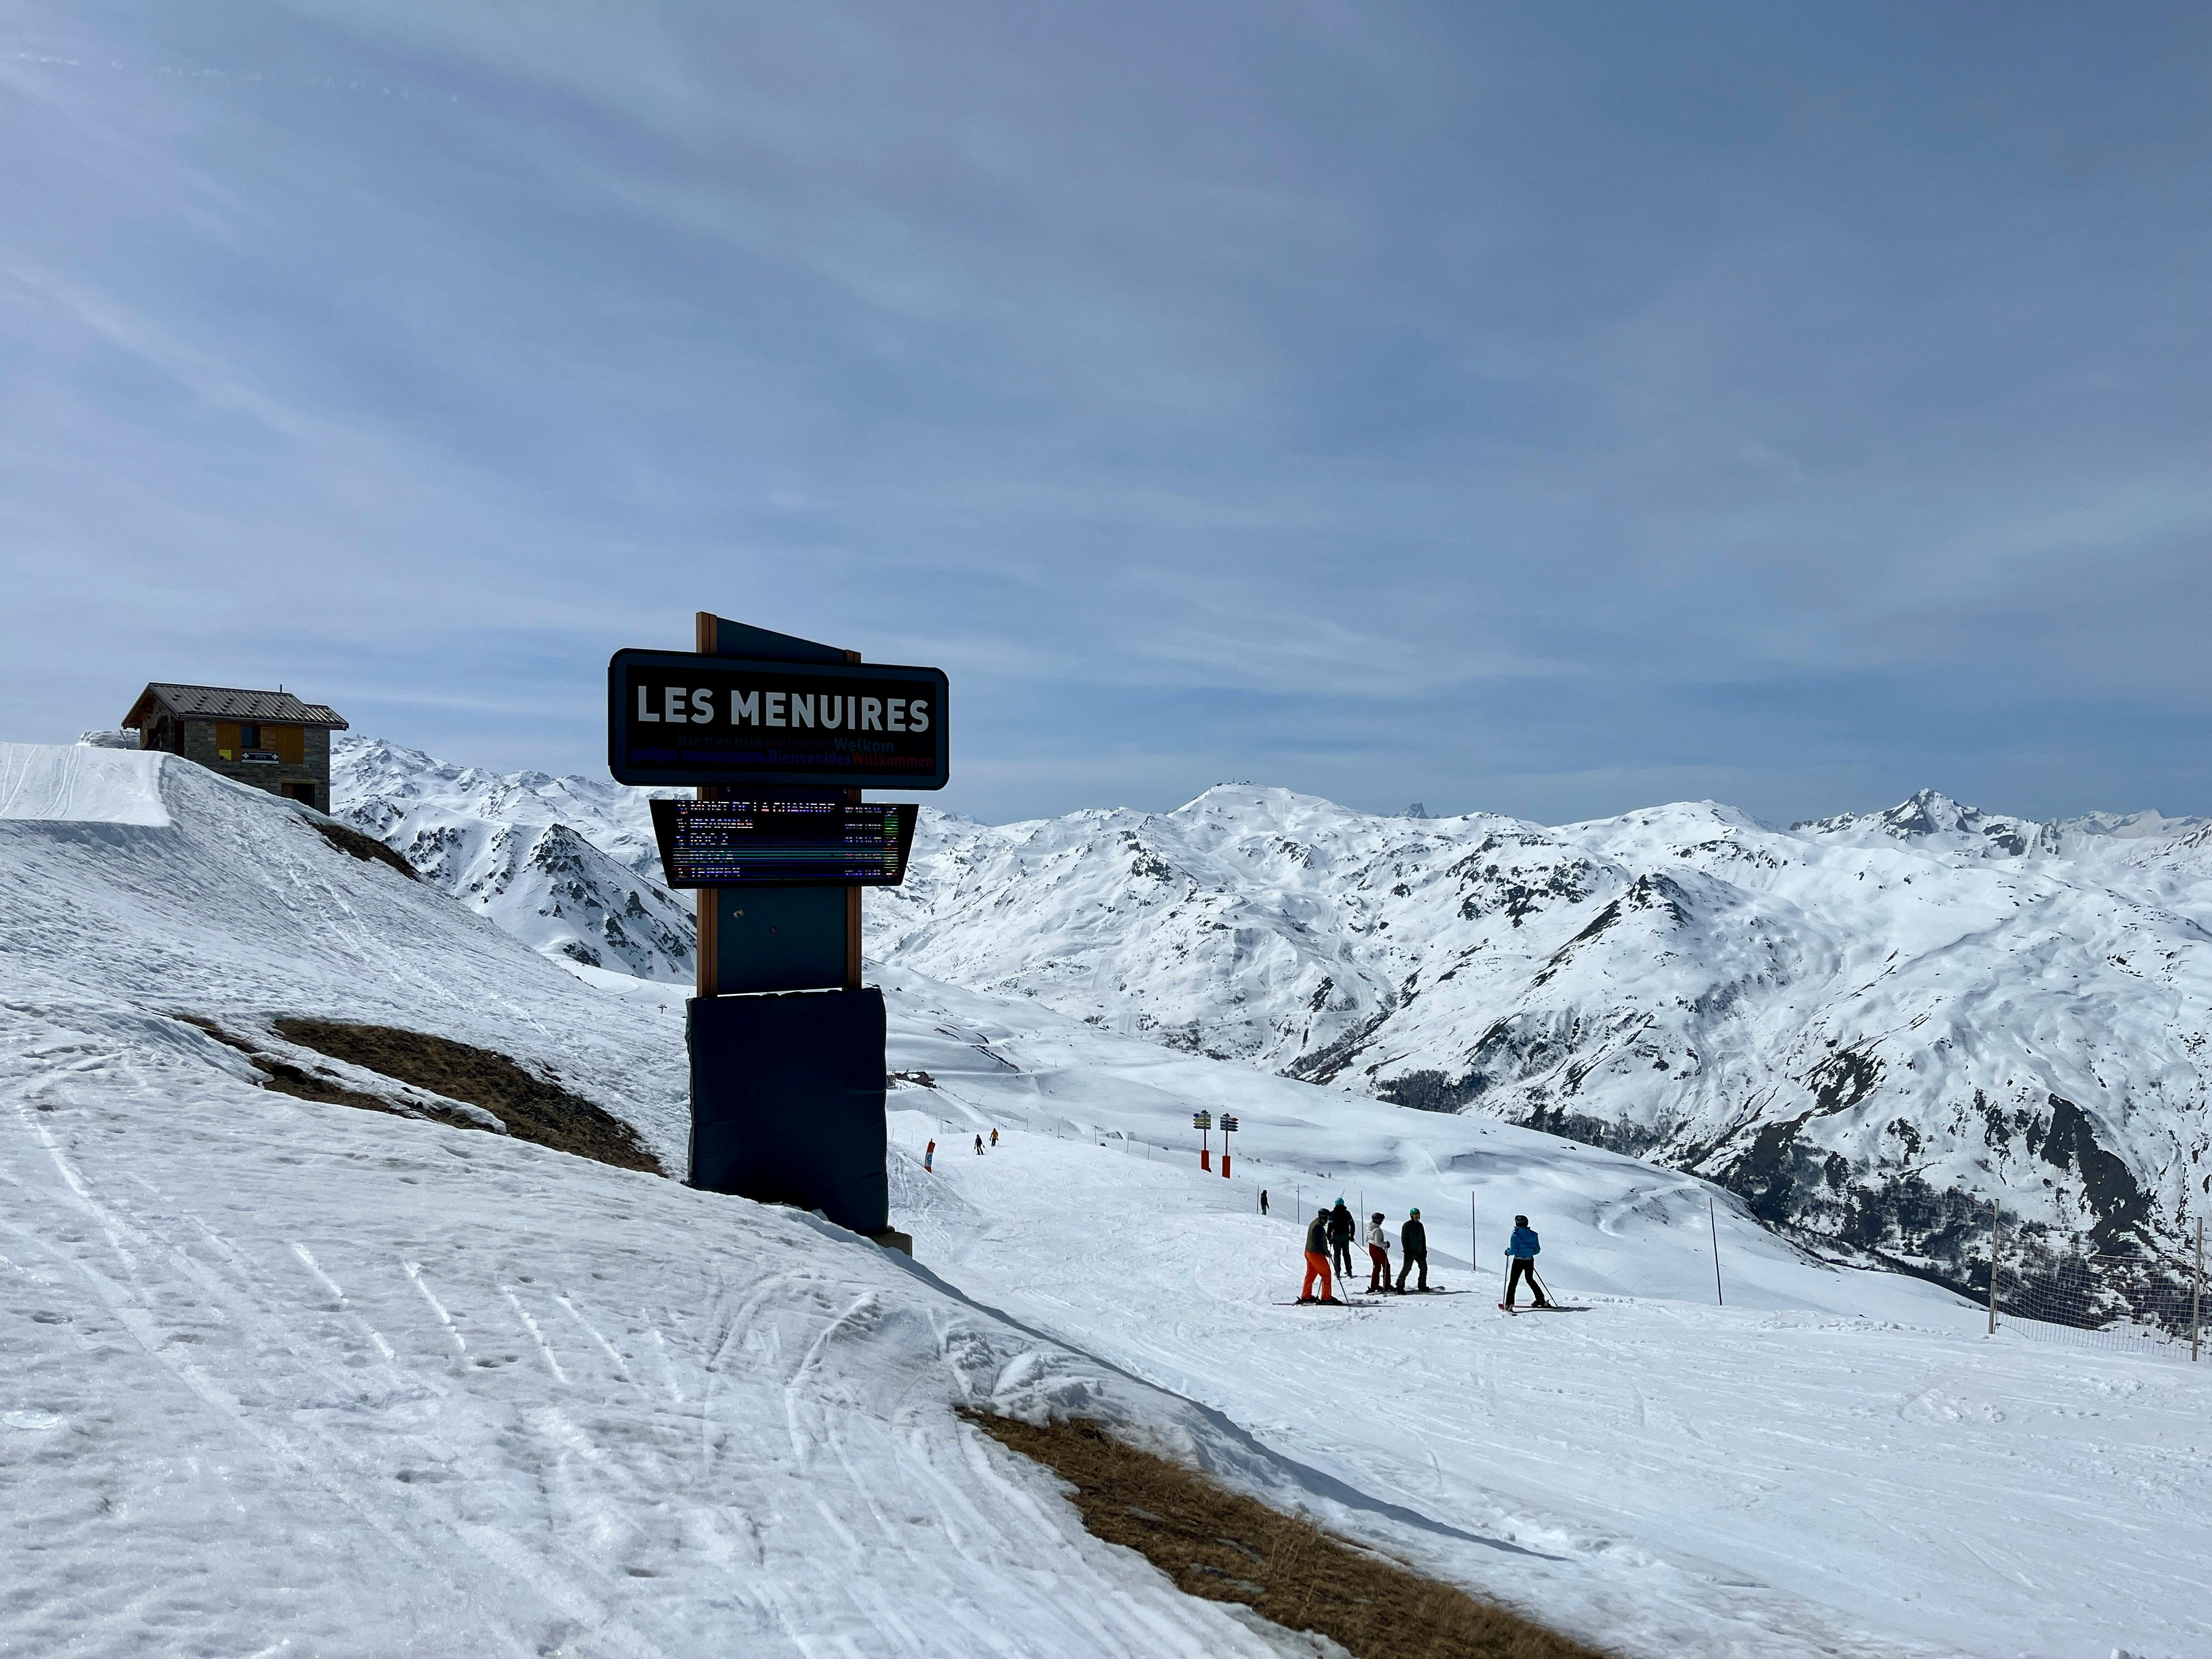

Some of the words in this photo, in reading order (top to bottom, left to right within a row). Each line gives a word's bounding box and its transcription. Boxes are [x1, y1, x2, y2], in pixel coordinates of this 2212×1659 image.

[637, 685, 714, 724] LES
[731, 690, 929, 732] MENUIRES
[833, 737, 895, 753] Welkom
[769, 750, 851, 765] Bienvenidos
[851, 752, 934, 768] Willkommen
